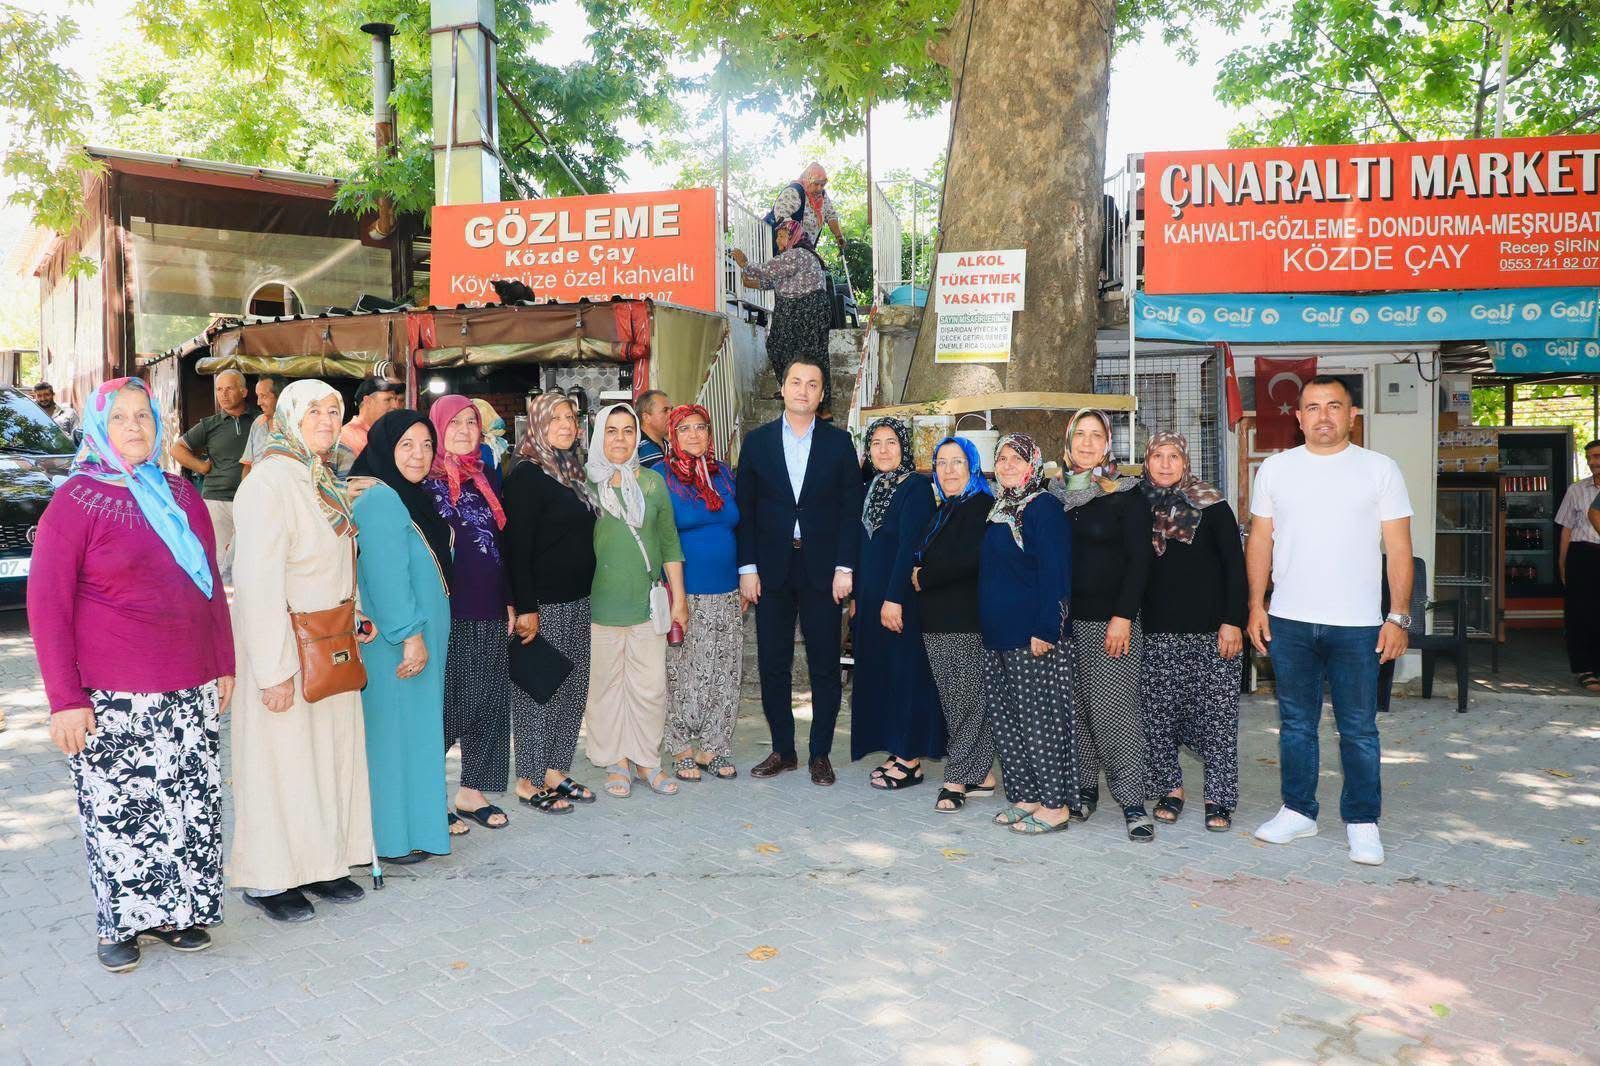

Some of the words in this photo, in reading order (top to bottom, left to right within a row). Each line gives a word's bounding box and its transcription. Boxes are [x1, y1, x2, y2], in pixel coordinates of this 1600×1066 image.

[1159, 156, 1394, 217] ÇINARALTI
[1411, 149, 1600, 199] MARKET
[465, 203, 680, 248] GÖZLEME
[505, 248, 580, 267] Közde
[588, 244, 636, 267] Çay
[1500, 241, 1549, 256] Recep
[1554, 237, 1599, 256] ŞİRİN
[957, 255, 1005, 267] ALKOL
[1283, 243, 1394, 273] KÖZDE
[1404, 243, 1470, 277] ÇAY
[1499, 258, 1532, 270] 0553
[1536, 258, 1558, 269] 741
[1563, 257, 1579, 268] 82
[1583, 256, 1599, 268] 07
[564, 266, 606, 287] özel
[614, 263, 695, 286] kahvaltı
[940, 273, 1021, 286] TÜKETMEK
[943, 292, 1016, 304] YASAKTIR
[1142, 305, 1182, 322] Golf
[1213, 307, 1255, 323] Golf
[1301, 307, 1344, 323] Golf
[1377, 305, 1422, 322] Golf
[1471, 303, 1516, 320] Golf
[1550, 300, 1595, 318] Golf
[1545, 341, 1579, 356] Golf
